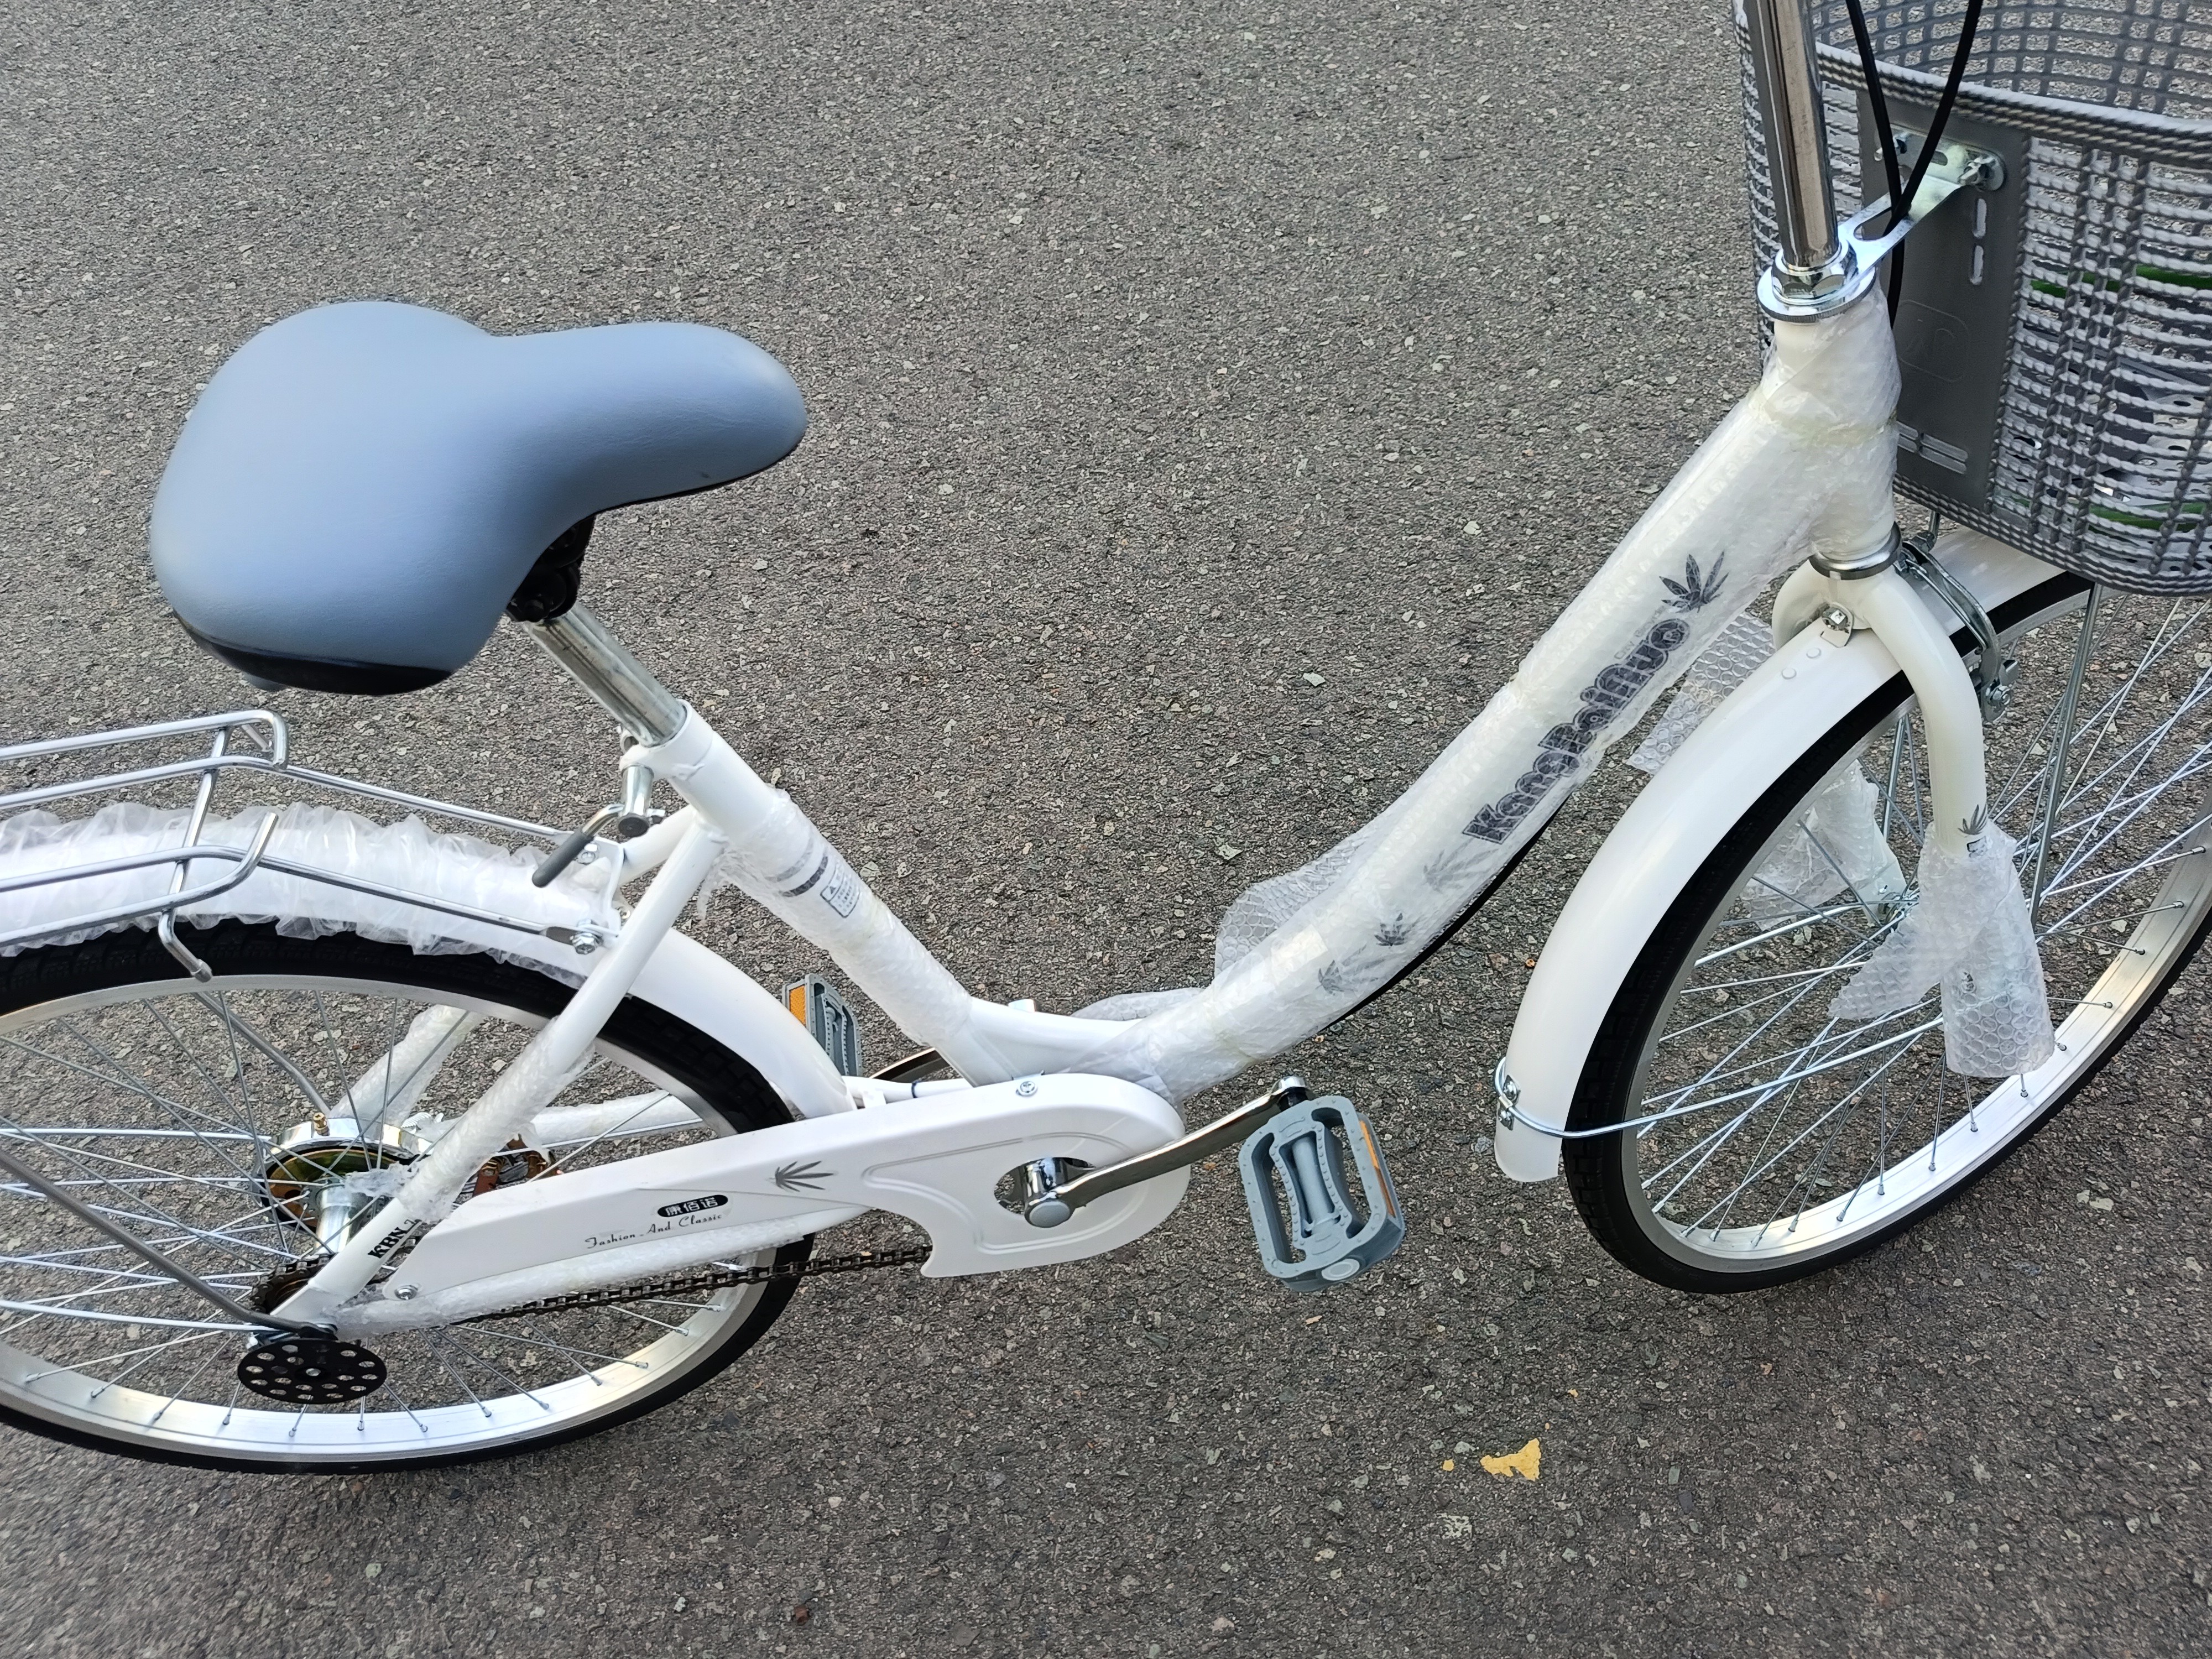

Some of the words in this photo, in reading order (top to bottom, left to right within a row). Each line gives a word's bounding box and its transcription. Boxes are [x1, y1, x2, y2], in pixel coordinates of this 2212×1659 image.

[585, 1233, 635, 1249] Fashion
[647, 1221, 671, 1234] And
[679, 1214, 722, 1227] Classic
